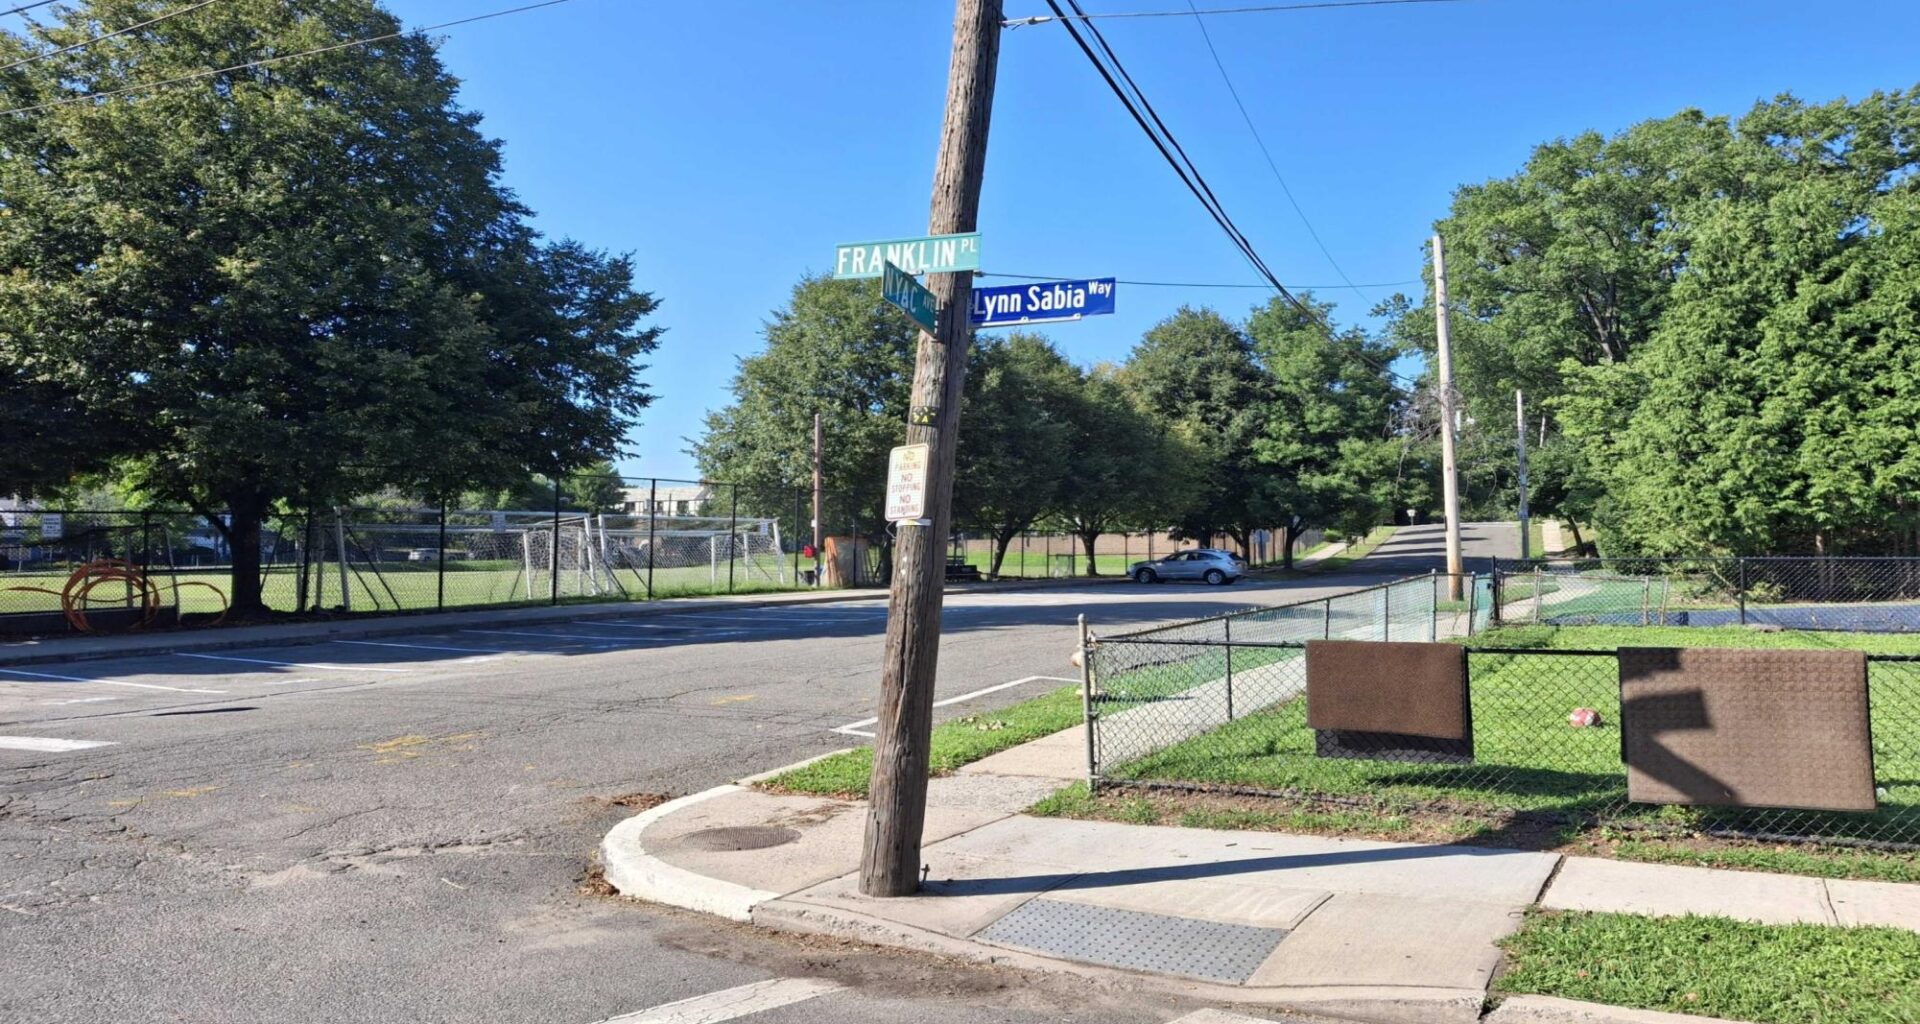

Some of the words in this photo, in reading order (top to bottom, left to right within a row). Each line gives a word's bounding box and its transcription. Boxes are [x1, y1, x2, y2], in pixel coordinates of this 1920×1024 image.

[837, 239, 956, 275] FRANKLIN
[960, 238, 977, 253] PL
[885, 266, 918, 313] NYAC
[974, 290, 1022, 321] Lynn
[1026, 284, 1086, 312] Sabia
[1088, 281, 1112, 298] Way
[901, 473, 913, 482] NO
[891, 482, 922, 494] STOPPING
[900, 494, 912, 504] NO
[890, 503, 920, 514] STANDING
